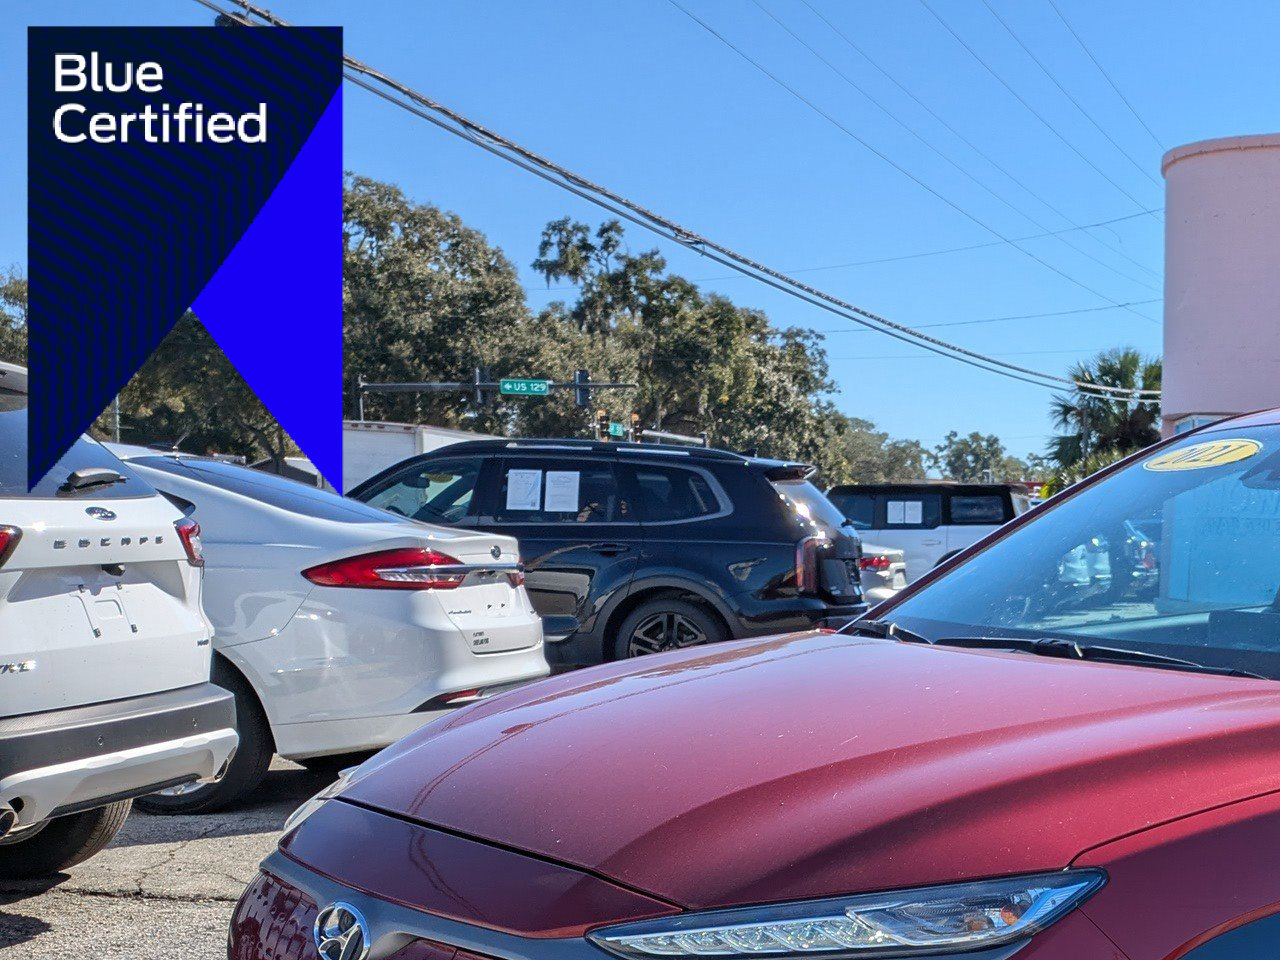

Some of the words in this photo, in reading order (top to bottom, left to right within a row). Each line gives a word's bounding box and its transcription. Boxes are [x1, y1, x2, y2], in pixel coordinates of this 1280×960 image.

[513, 383, 527, 391] US
[530, 382, 546, 391] 129
[1153, 444, 1249, 466] 2021
[53, 535, 163, 549] ESCAPE
